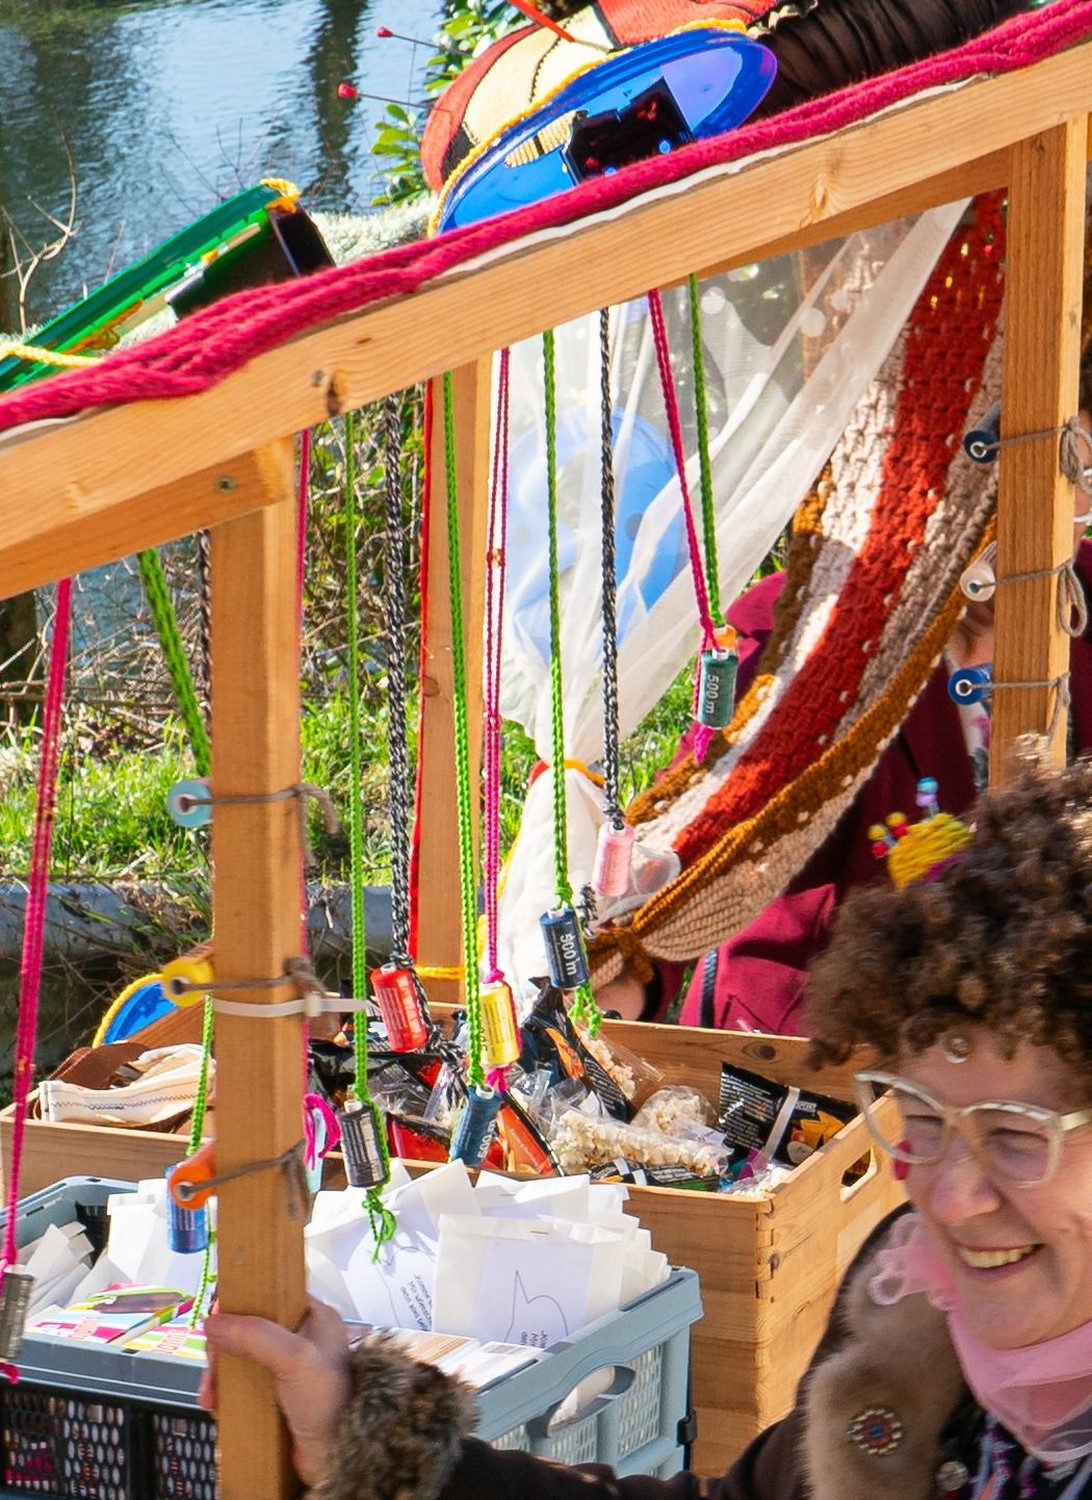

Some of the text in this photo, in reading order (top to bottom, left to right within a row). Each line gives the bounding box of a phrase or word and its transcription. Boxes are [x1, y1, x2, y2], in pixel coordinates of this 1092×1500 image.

[705, 674, 720, 714] 500 m
[560, 933, 577, 976] 500 m
